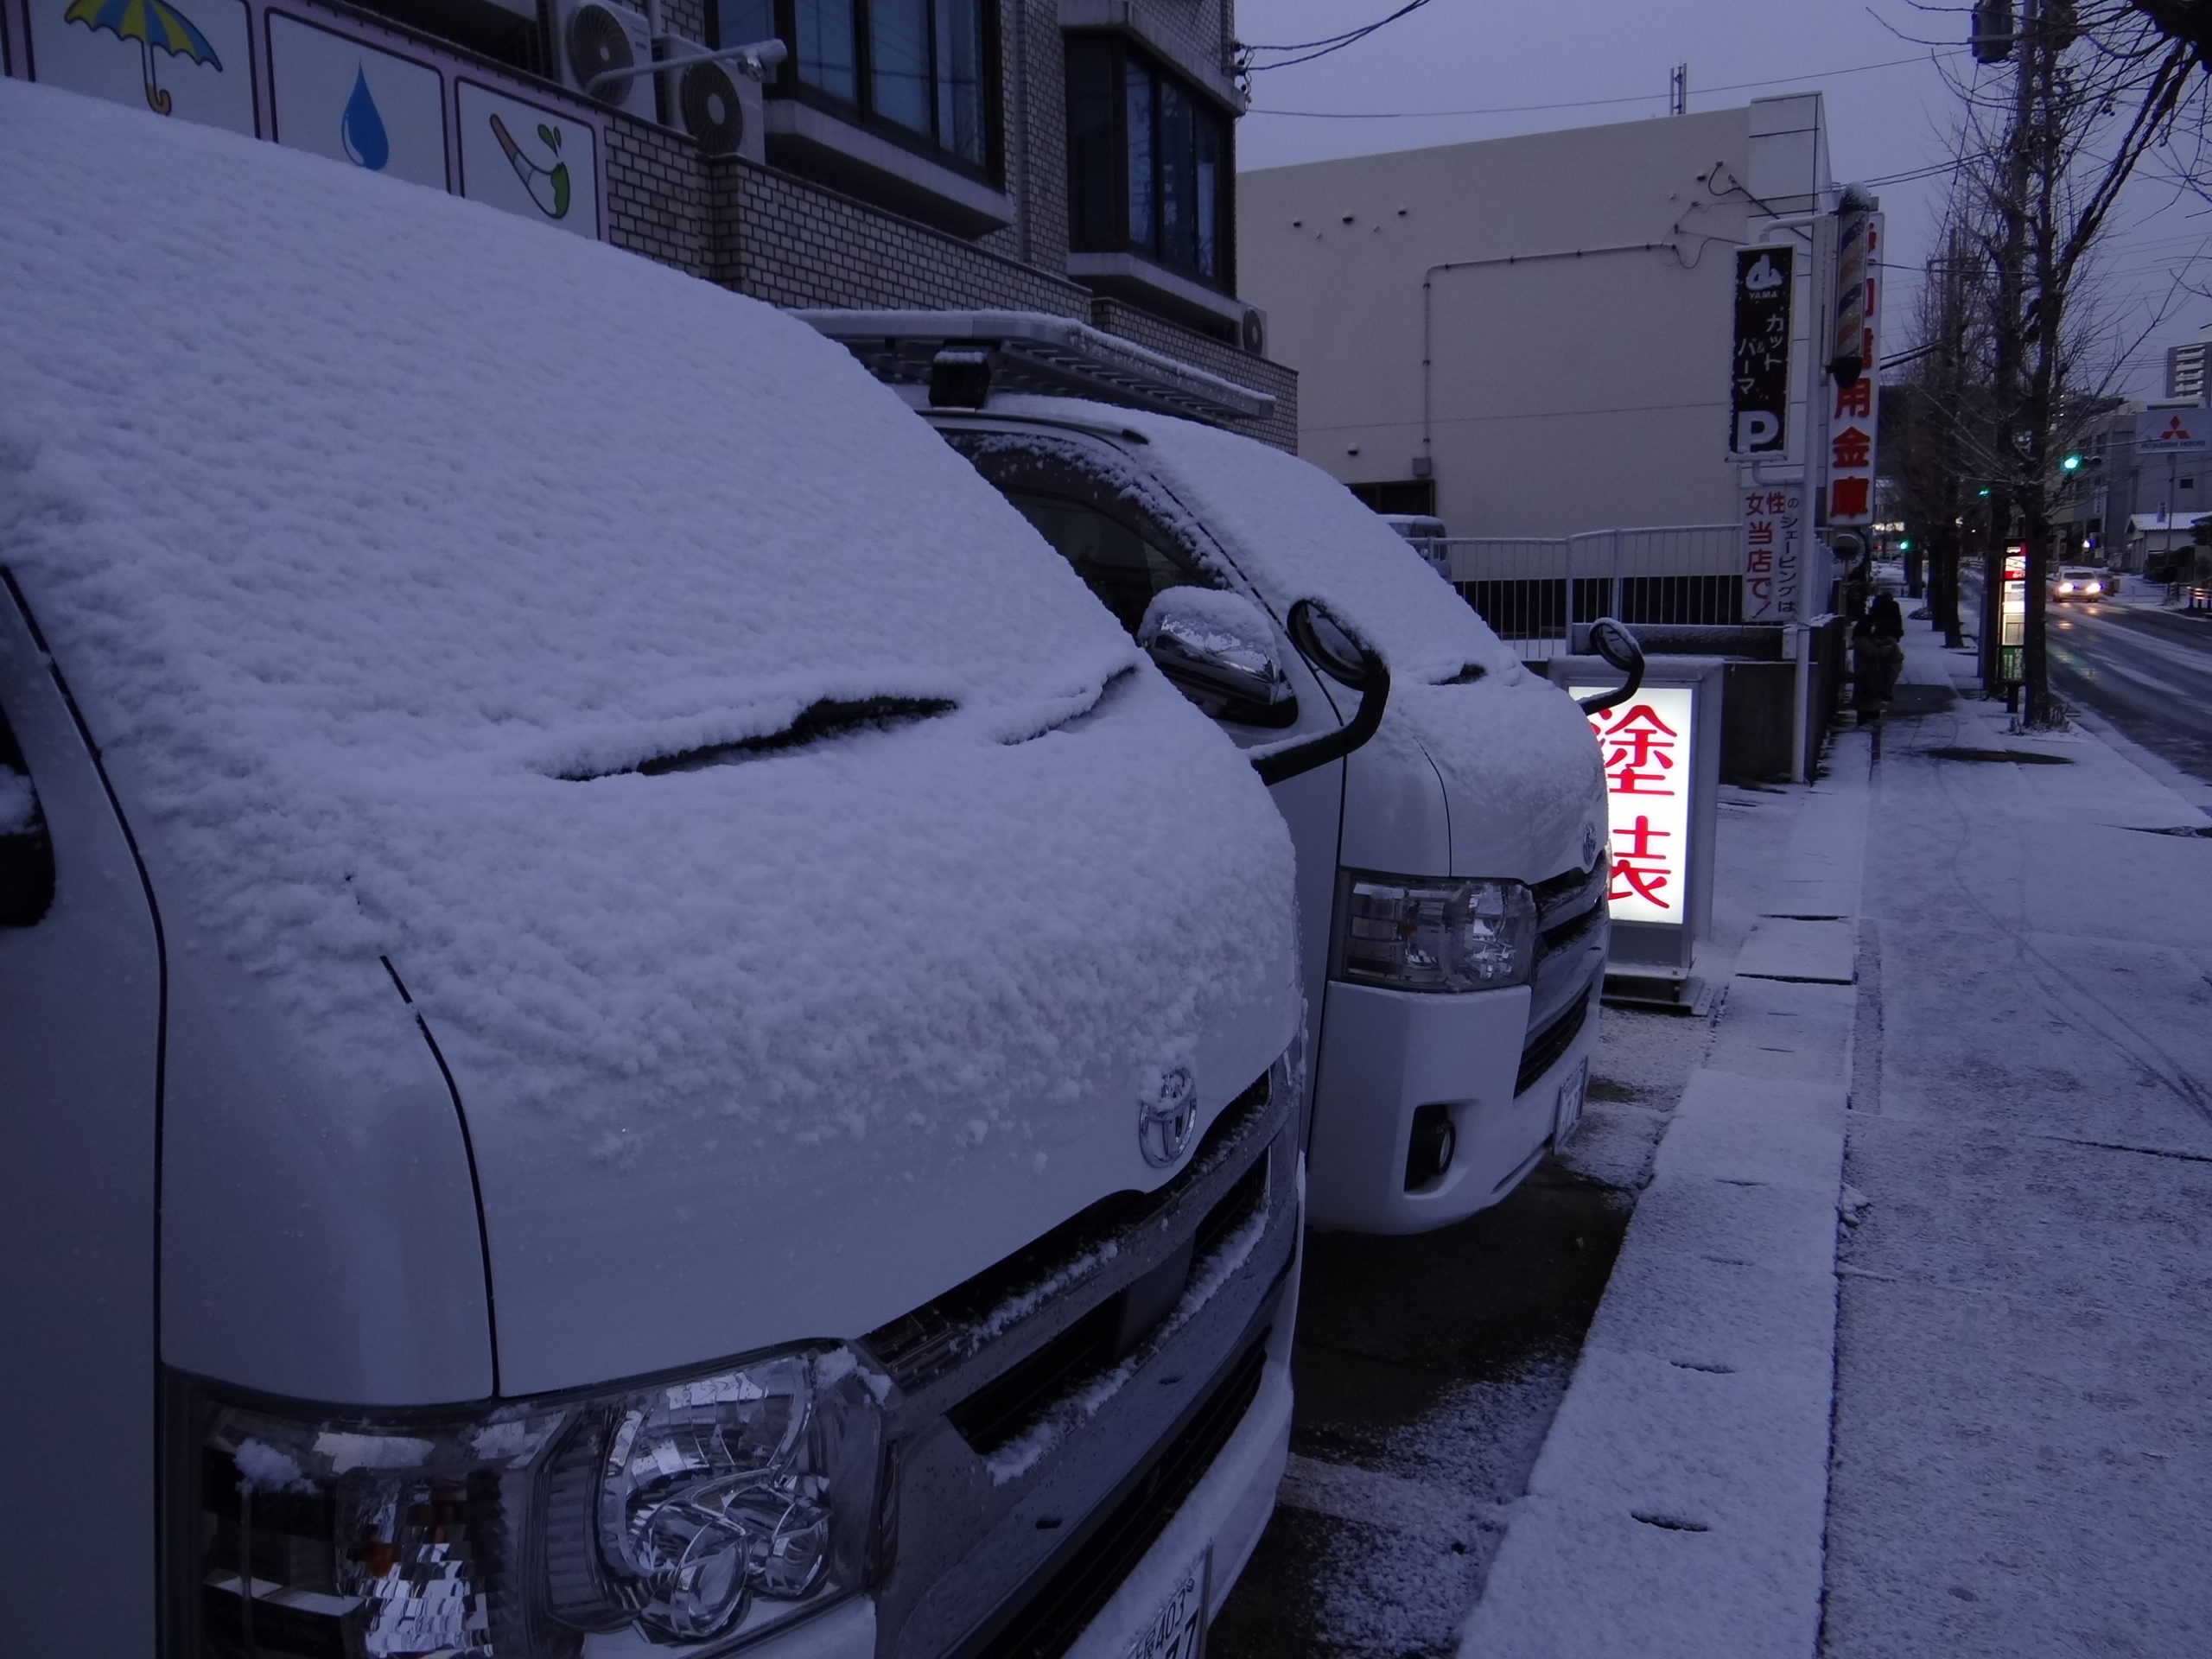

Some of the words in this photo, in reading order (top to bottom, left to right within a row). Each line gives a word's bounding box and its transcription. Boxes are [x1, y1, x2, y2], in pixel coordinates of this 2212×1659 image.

[1748, 290, 1779, 301] YAMA
[1737, 337, 1758, 395] パーマ
[1764, 314, 1784, 372] カット
[1737, 410, 1781, 454] P
